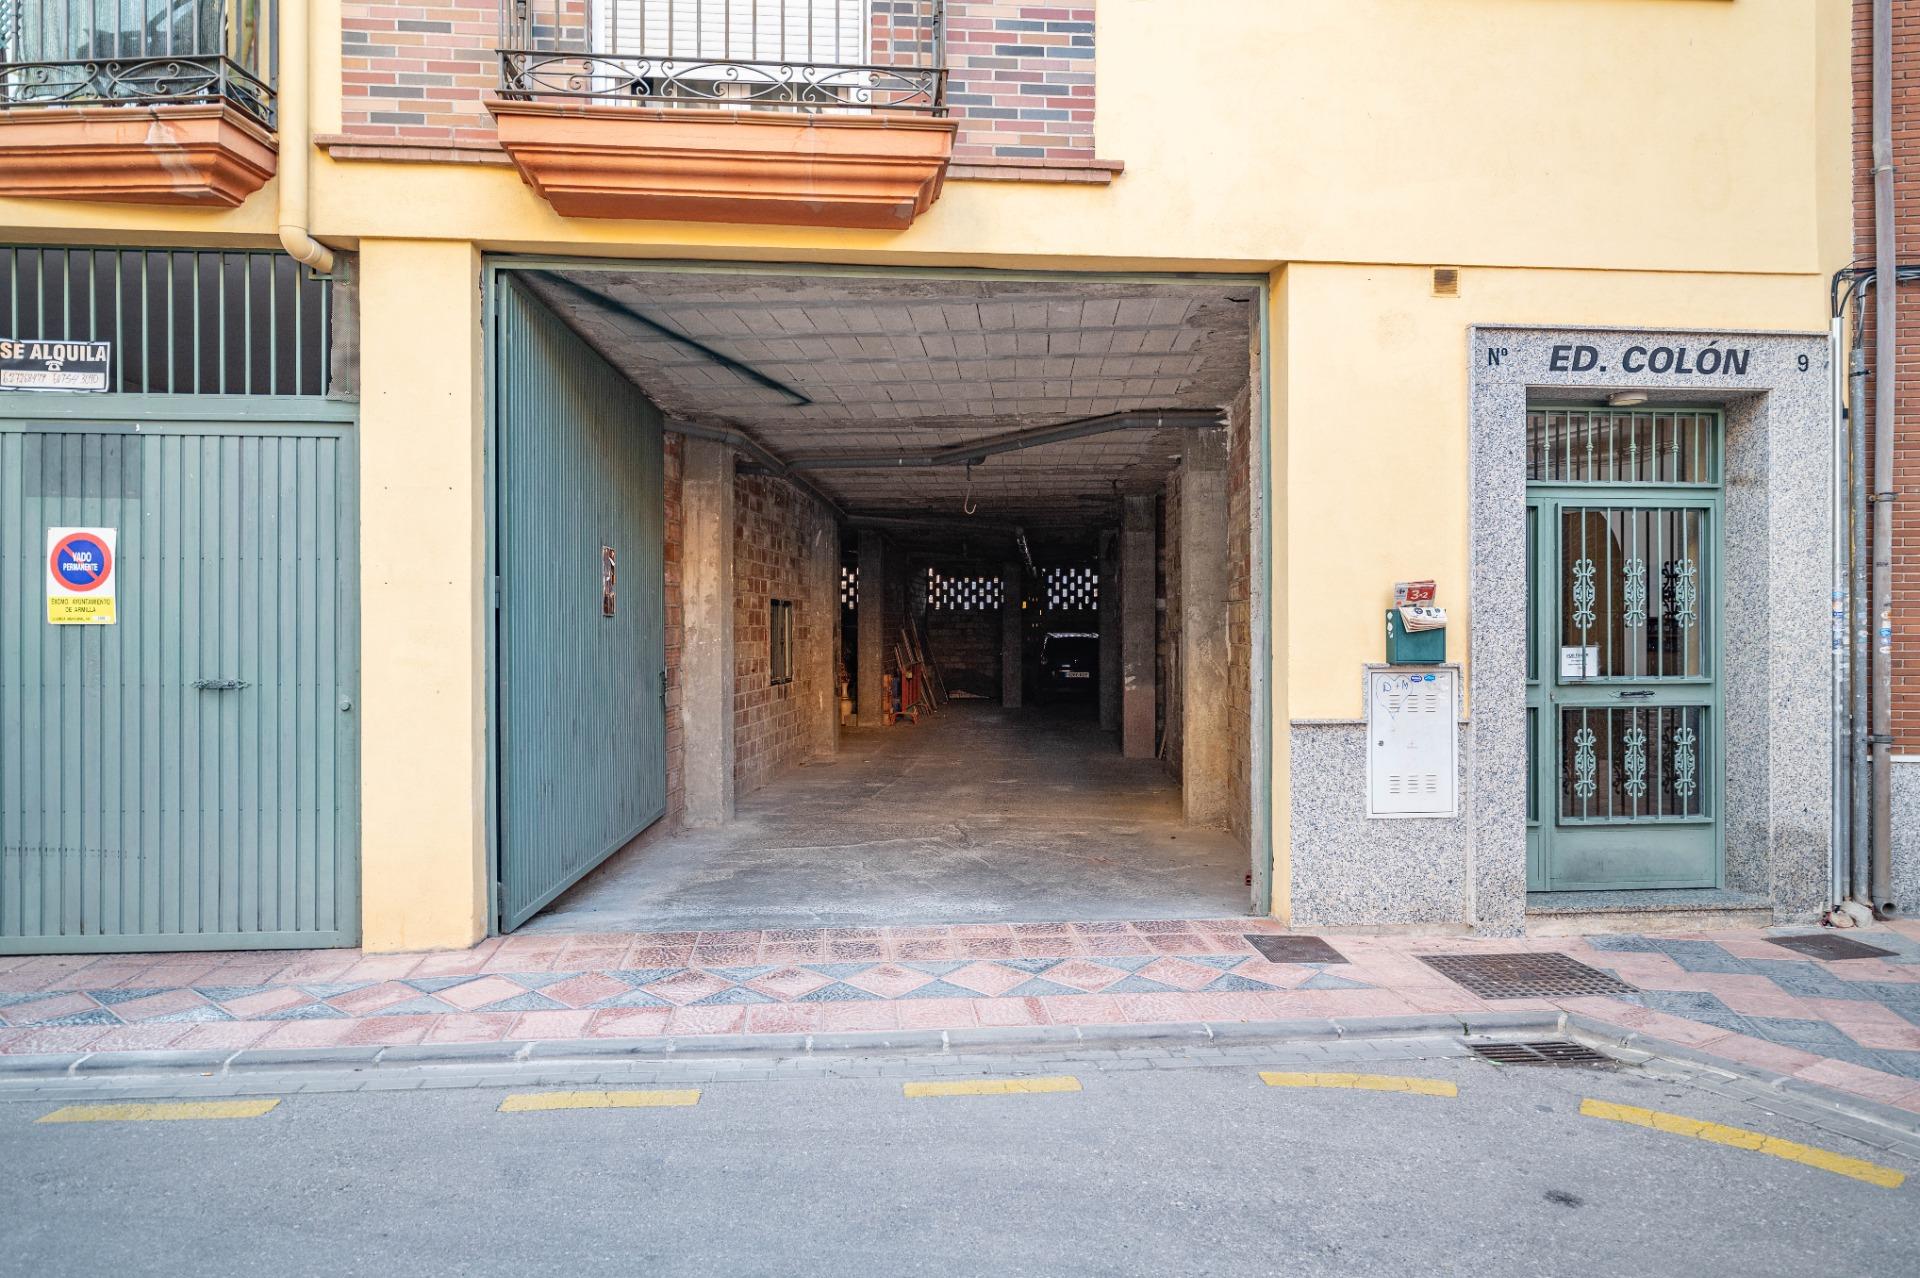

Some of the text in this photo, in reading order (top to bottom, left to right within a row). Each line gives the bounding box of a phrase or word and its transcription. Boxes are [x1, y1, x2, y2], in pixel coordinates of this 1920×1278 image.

[0, 342, 107, 362] SE ALQUILA
[1550, 345, 1607, 373] ED.
[1622, 340, 1750, 375] COLÓN
[1797, 354, 1809, 372] 9
[72, 552, 92, 562] VADO
[63, 563, 99, 571] PERMANENTE
